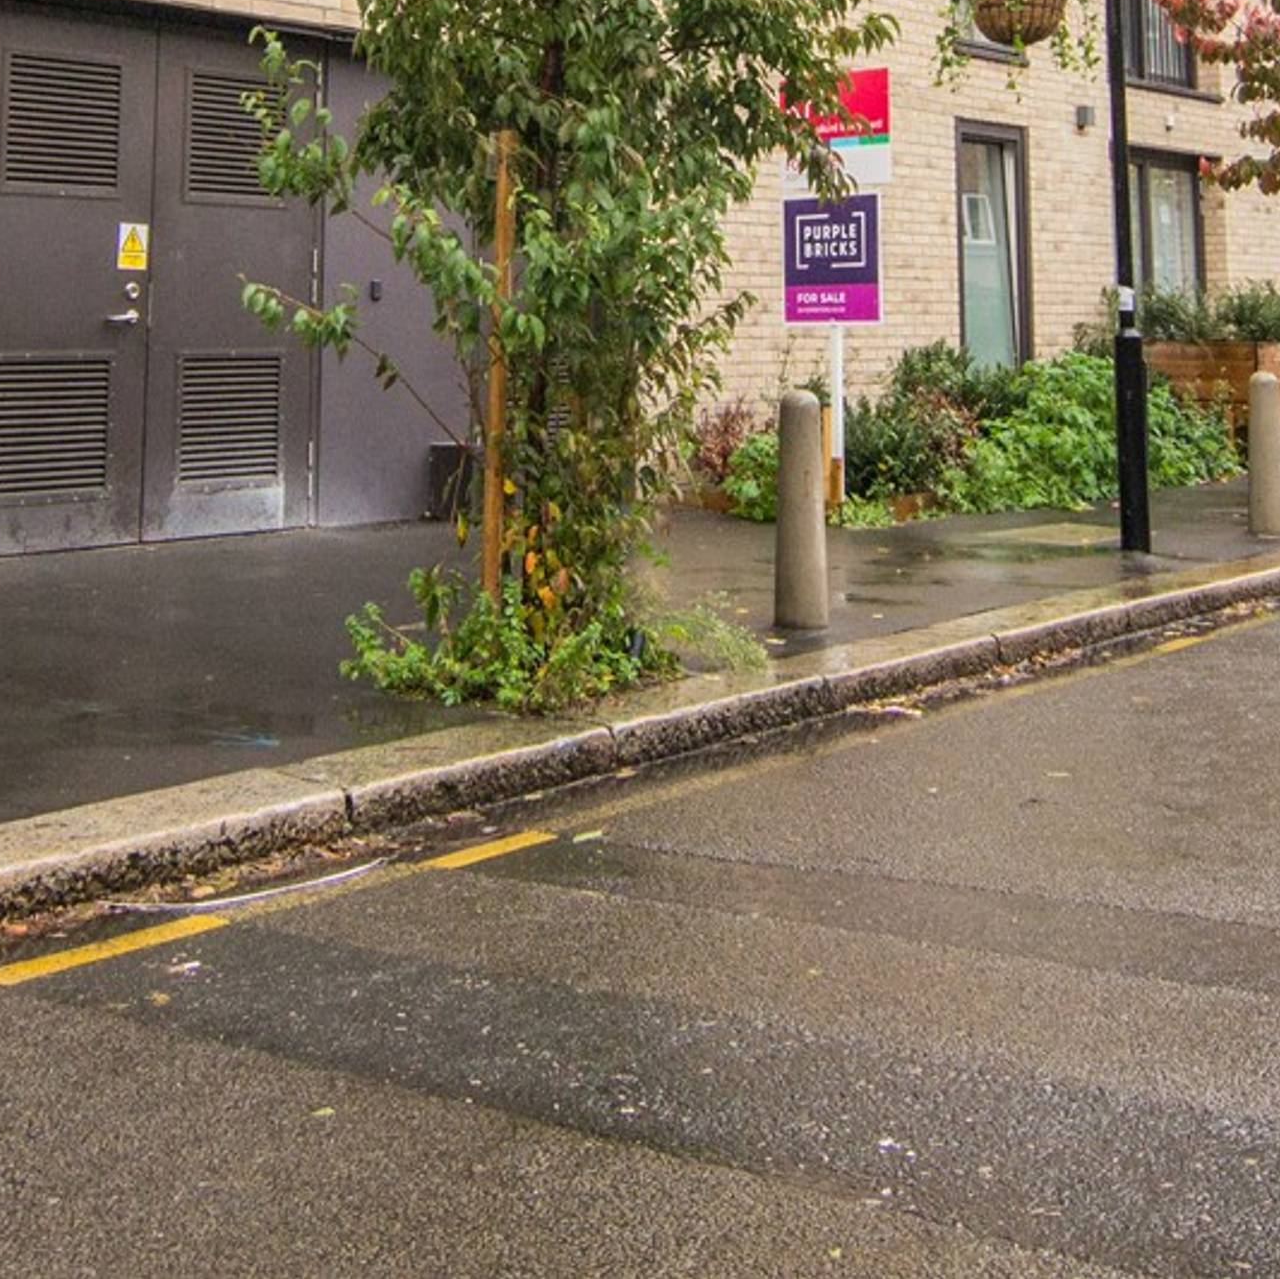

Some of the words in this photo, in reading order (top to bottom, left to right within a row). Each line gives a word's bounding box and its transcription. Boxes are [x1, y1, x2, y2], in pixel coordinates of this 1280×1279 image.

[803, 223, 857, 241] PURPLE
[803, 240, 858, 258] BRICKS
[796, 292, 818, 304] FOR
[820, 292, 846, 304] SALE
